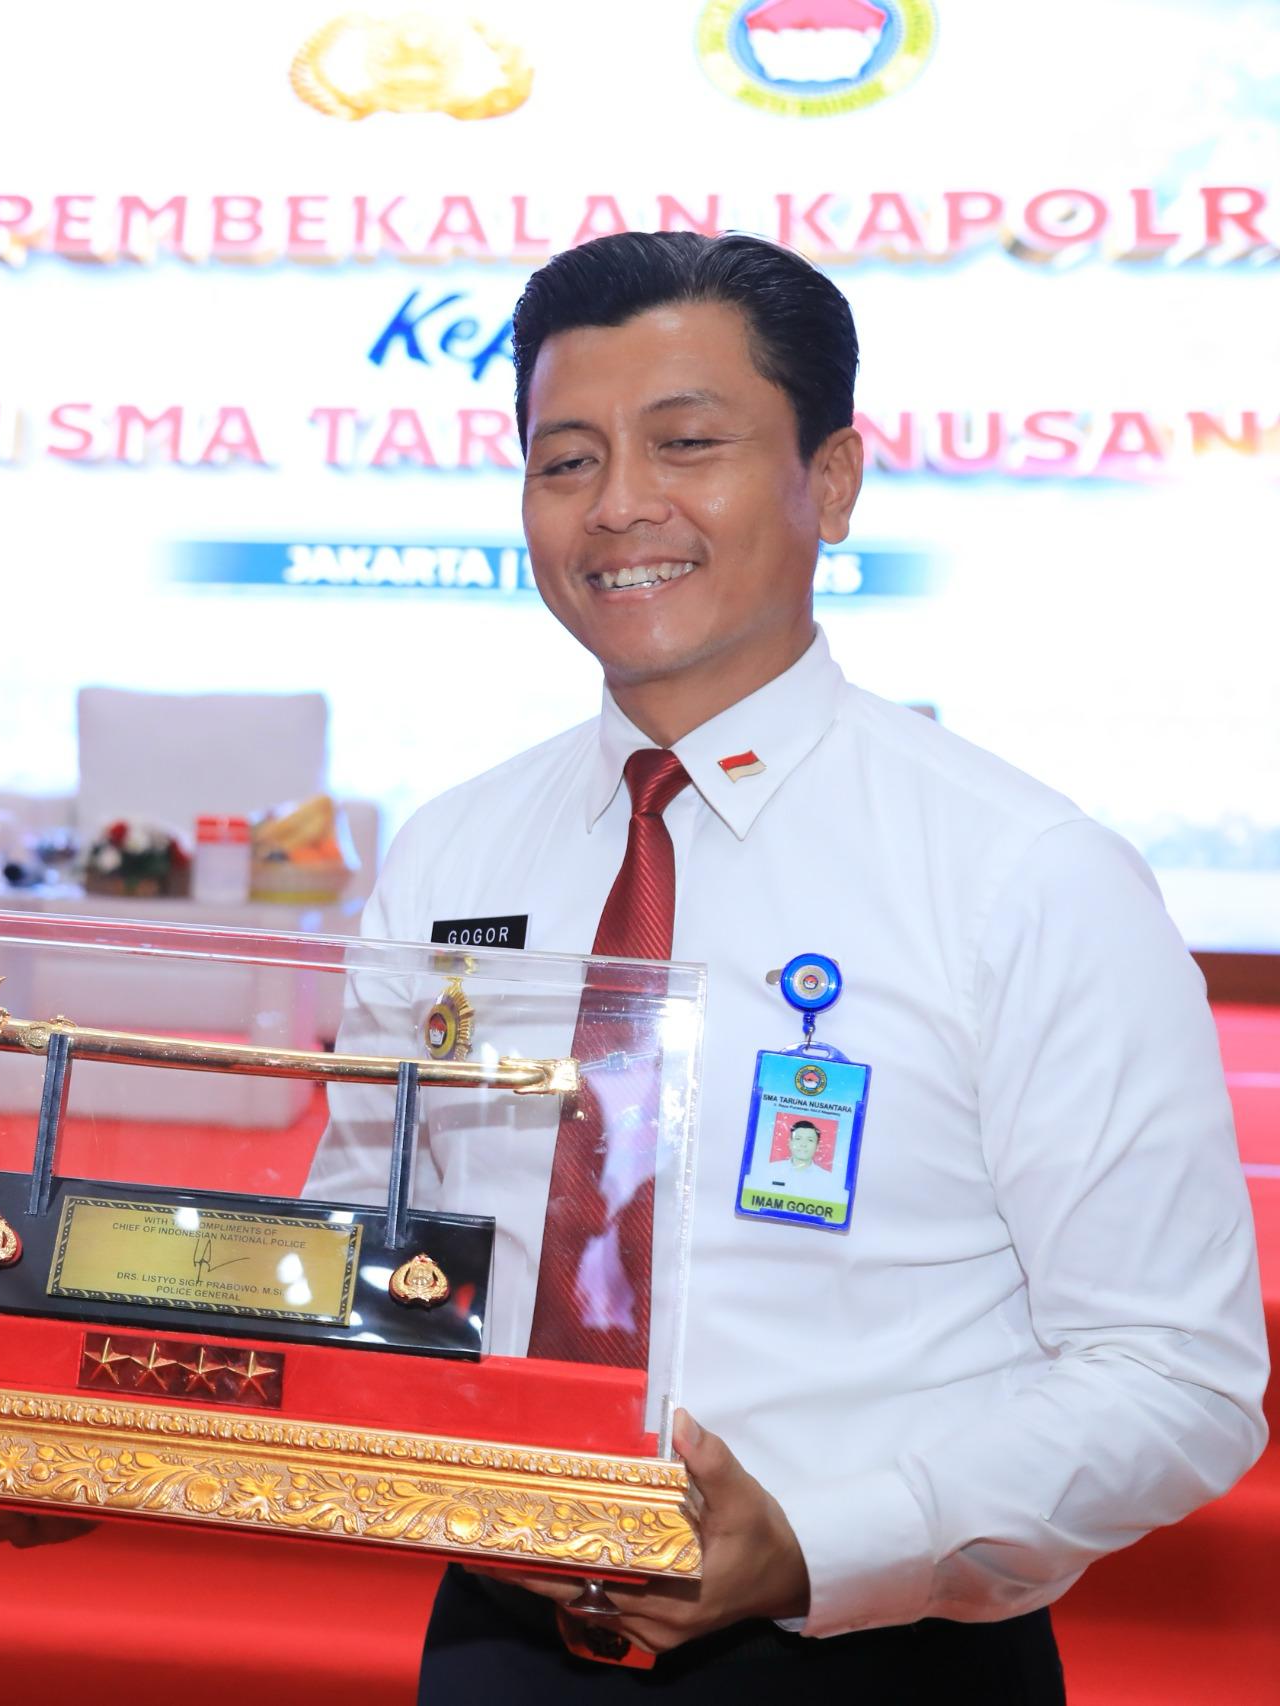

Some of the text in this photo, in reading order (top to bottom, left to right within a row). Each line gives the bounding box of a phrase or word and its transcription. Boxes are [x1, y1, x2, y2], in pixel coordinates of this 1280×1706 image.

[775, 187, 1278, 258] KAPOLR
[368, 290, 515, 381] Kep
[47, 402, 266, 470] SMA
[310, 405, 522, 470] TAR
[854, 410, 1278, 474] NUSAN
[284, 544, 496, 590] JAKARTA
[448, 926, 509, 945] GOGOR
[763, 1094, 778, 1102] SMA
[779, 1096, 808, 1107] TARUNA
[809, 1101, 852, 1113] NUSANTARA
[751, 1195, 834, 1218] IMAM GOGOR
[112, 1222, 307, 1249] CHIEF OF INDONESIAN NATIONAL POLICE
[144, 1216, 168, 1225] WITH
[198, 1221, 261, 1235] OMPLIMENTS
[142, 1274, 177, 1285] LISTYO
[156, 1285, 241, 1301] POLICE GENERAL
